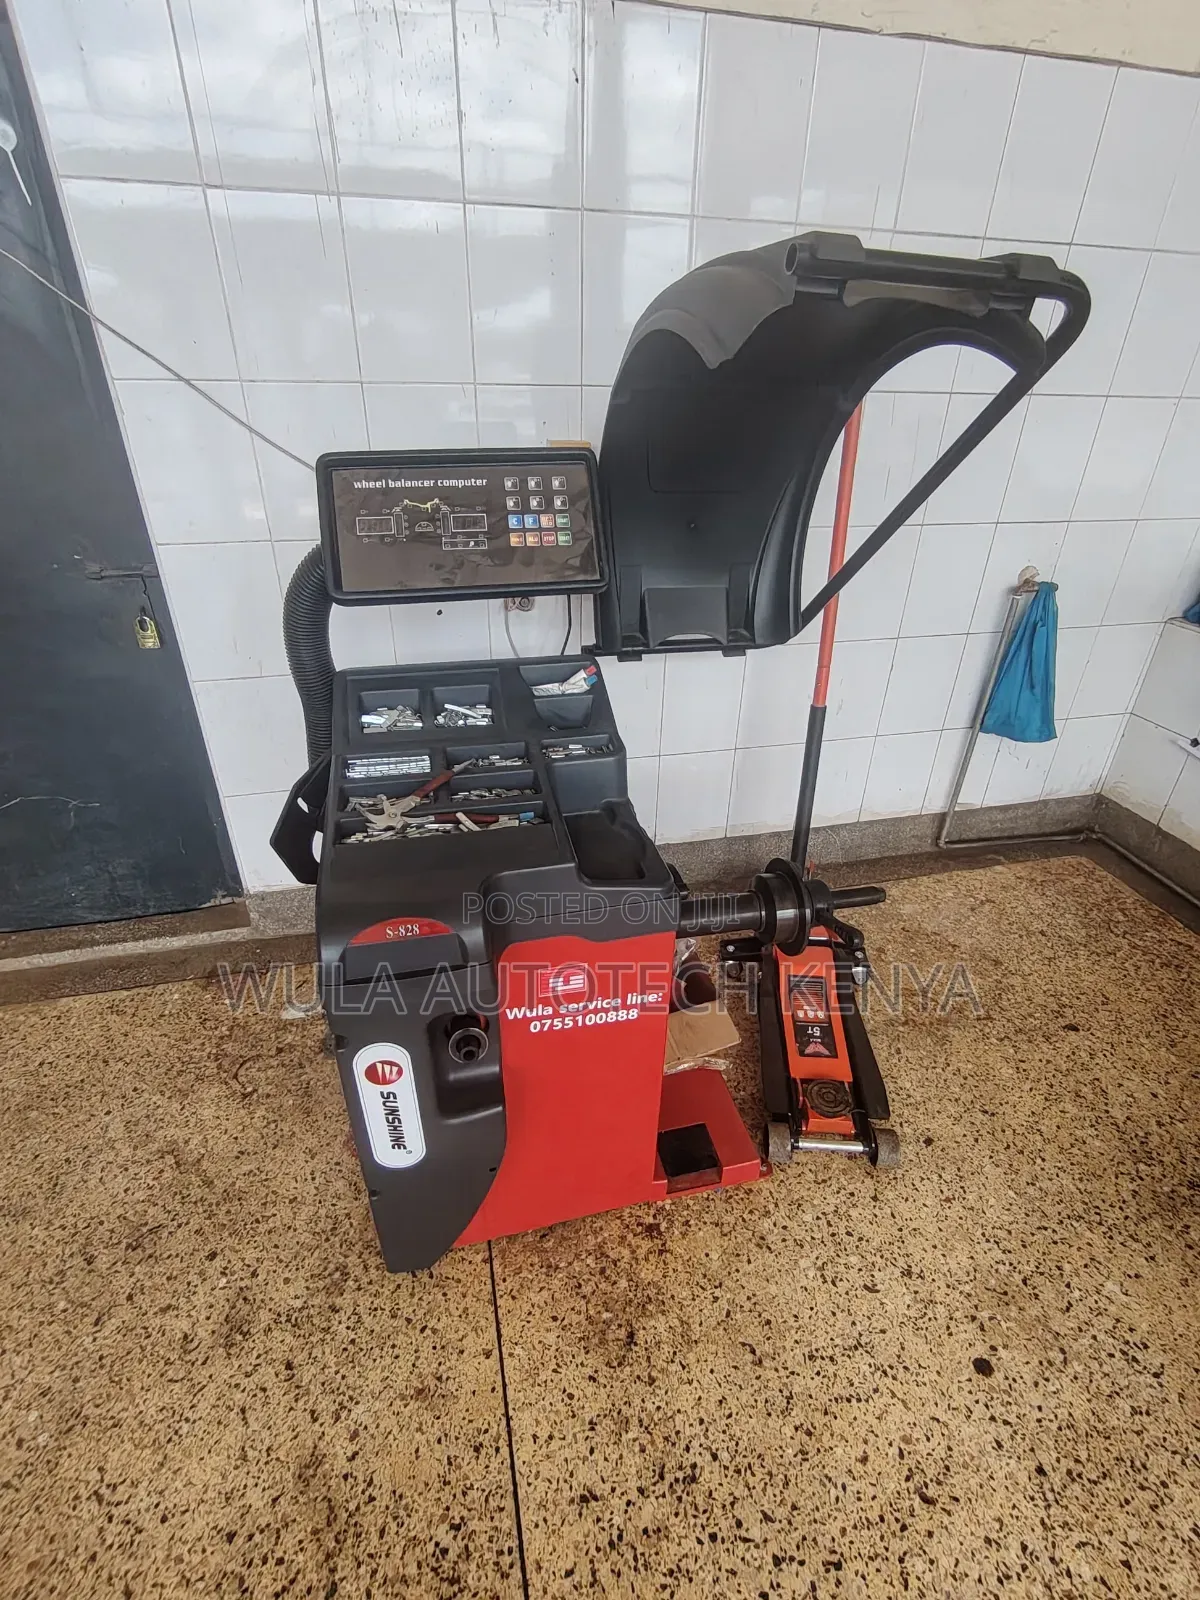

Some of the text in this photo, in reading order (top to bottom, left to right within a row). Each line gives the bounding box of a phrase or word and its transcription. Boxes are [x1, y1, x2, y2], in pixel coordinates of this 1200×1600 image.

[353, 478, 487, 488] wheel balancer computer
[385, 923, 420, 939] S-828
[505, 992, 664, 1020] Wula service line:
[529, 1008, 639, 1033] 0755100888
[806, 1026, 821, 1036] 5T
[380, 1090, 408, 1151] SUNSHINE
